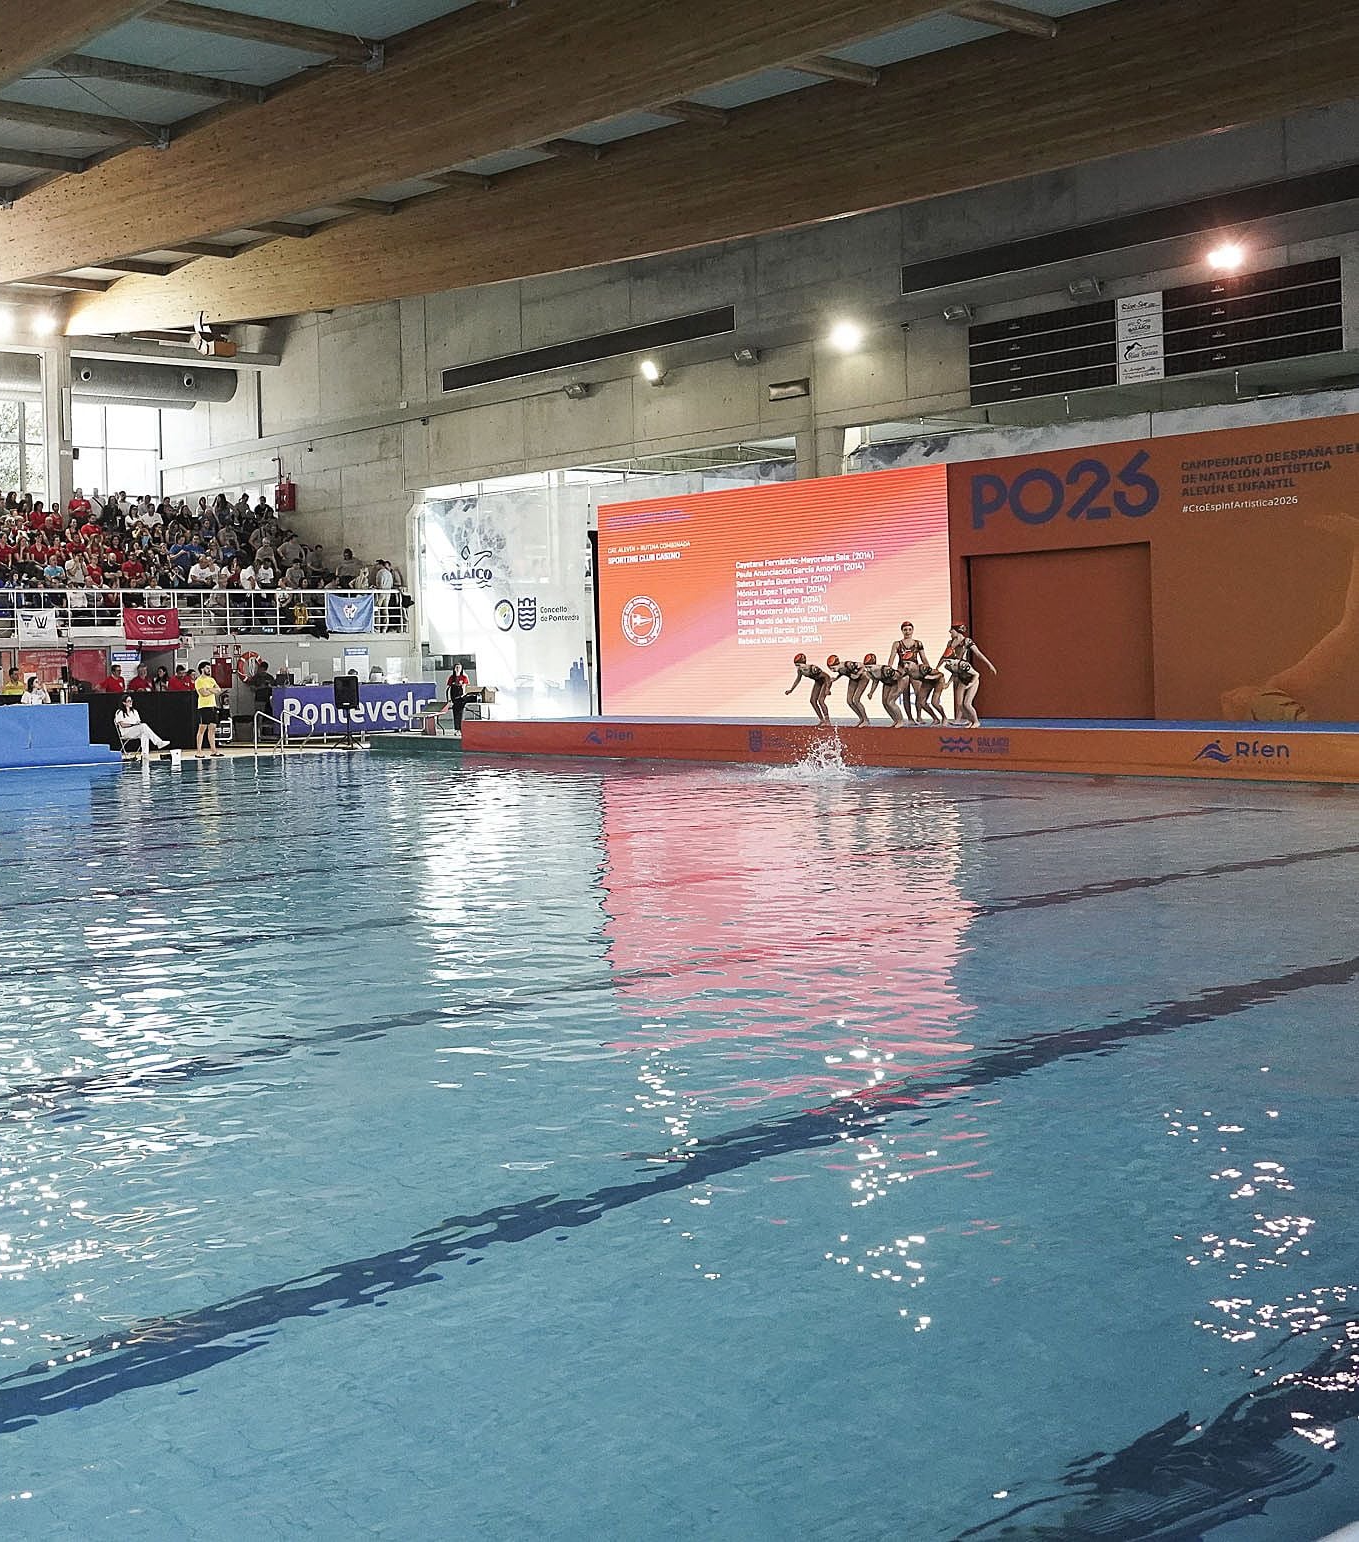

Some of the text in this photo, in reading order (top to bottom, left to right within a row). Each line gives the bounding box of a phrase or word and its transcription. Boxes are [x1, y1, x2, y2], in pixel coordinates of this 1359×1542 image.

[1181, 454, 1263, 471] CAMPEONATO
[1265, 452, 1282, 461] DE
[1282, 446, 1332, 461] ESPAÑA
[1337, 444, 1354, 454] DE
[1182, 460, 1331, 484] DE NATACIÓN ARTÍSTICA
[971, 449, 1159, 530] PO26
[1182, 478, 1295, 497] ALEVÍN E INFANTIL
[608, 551, 681, 565] SPORTING CLUB CASINO
[852, 551, 874, 560] (2014)
[843, 562, 865, 572] (2014)
[442, 568, 493, 582] GALAICO
[810, 575, 832, 584] (2014)
[760, 587, 779, 597] López
[806, 584, 827, 594] (2014)
[540, 605, 568, 614] Concello
[136, 614, 167, 625] CNG
[283, 691, 438, 726] Ponevedr
[1235, 740, 1290, 758] Rfen
